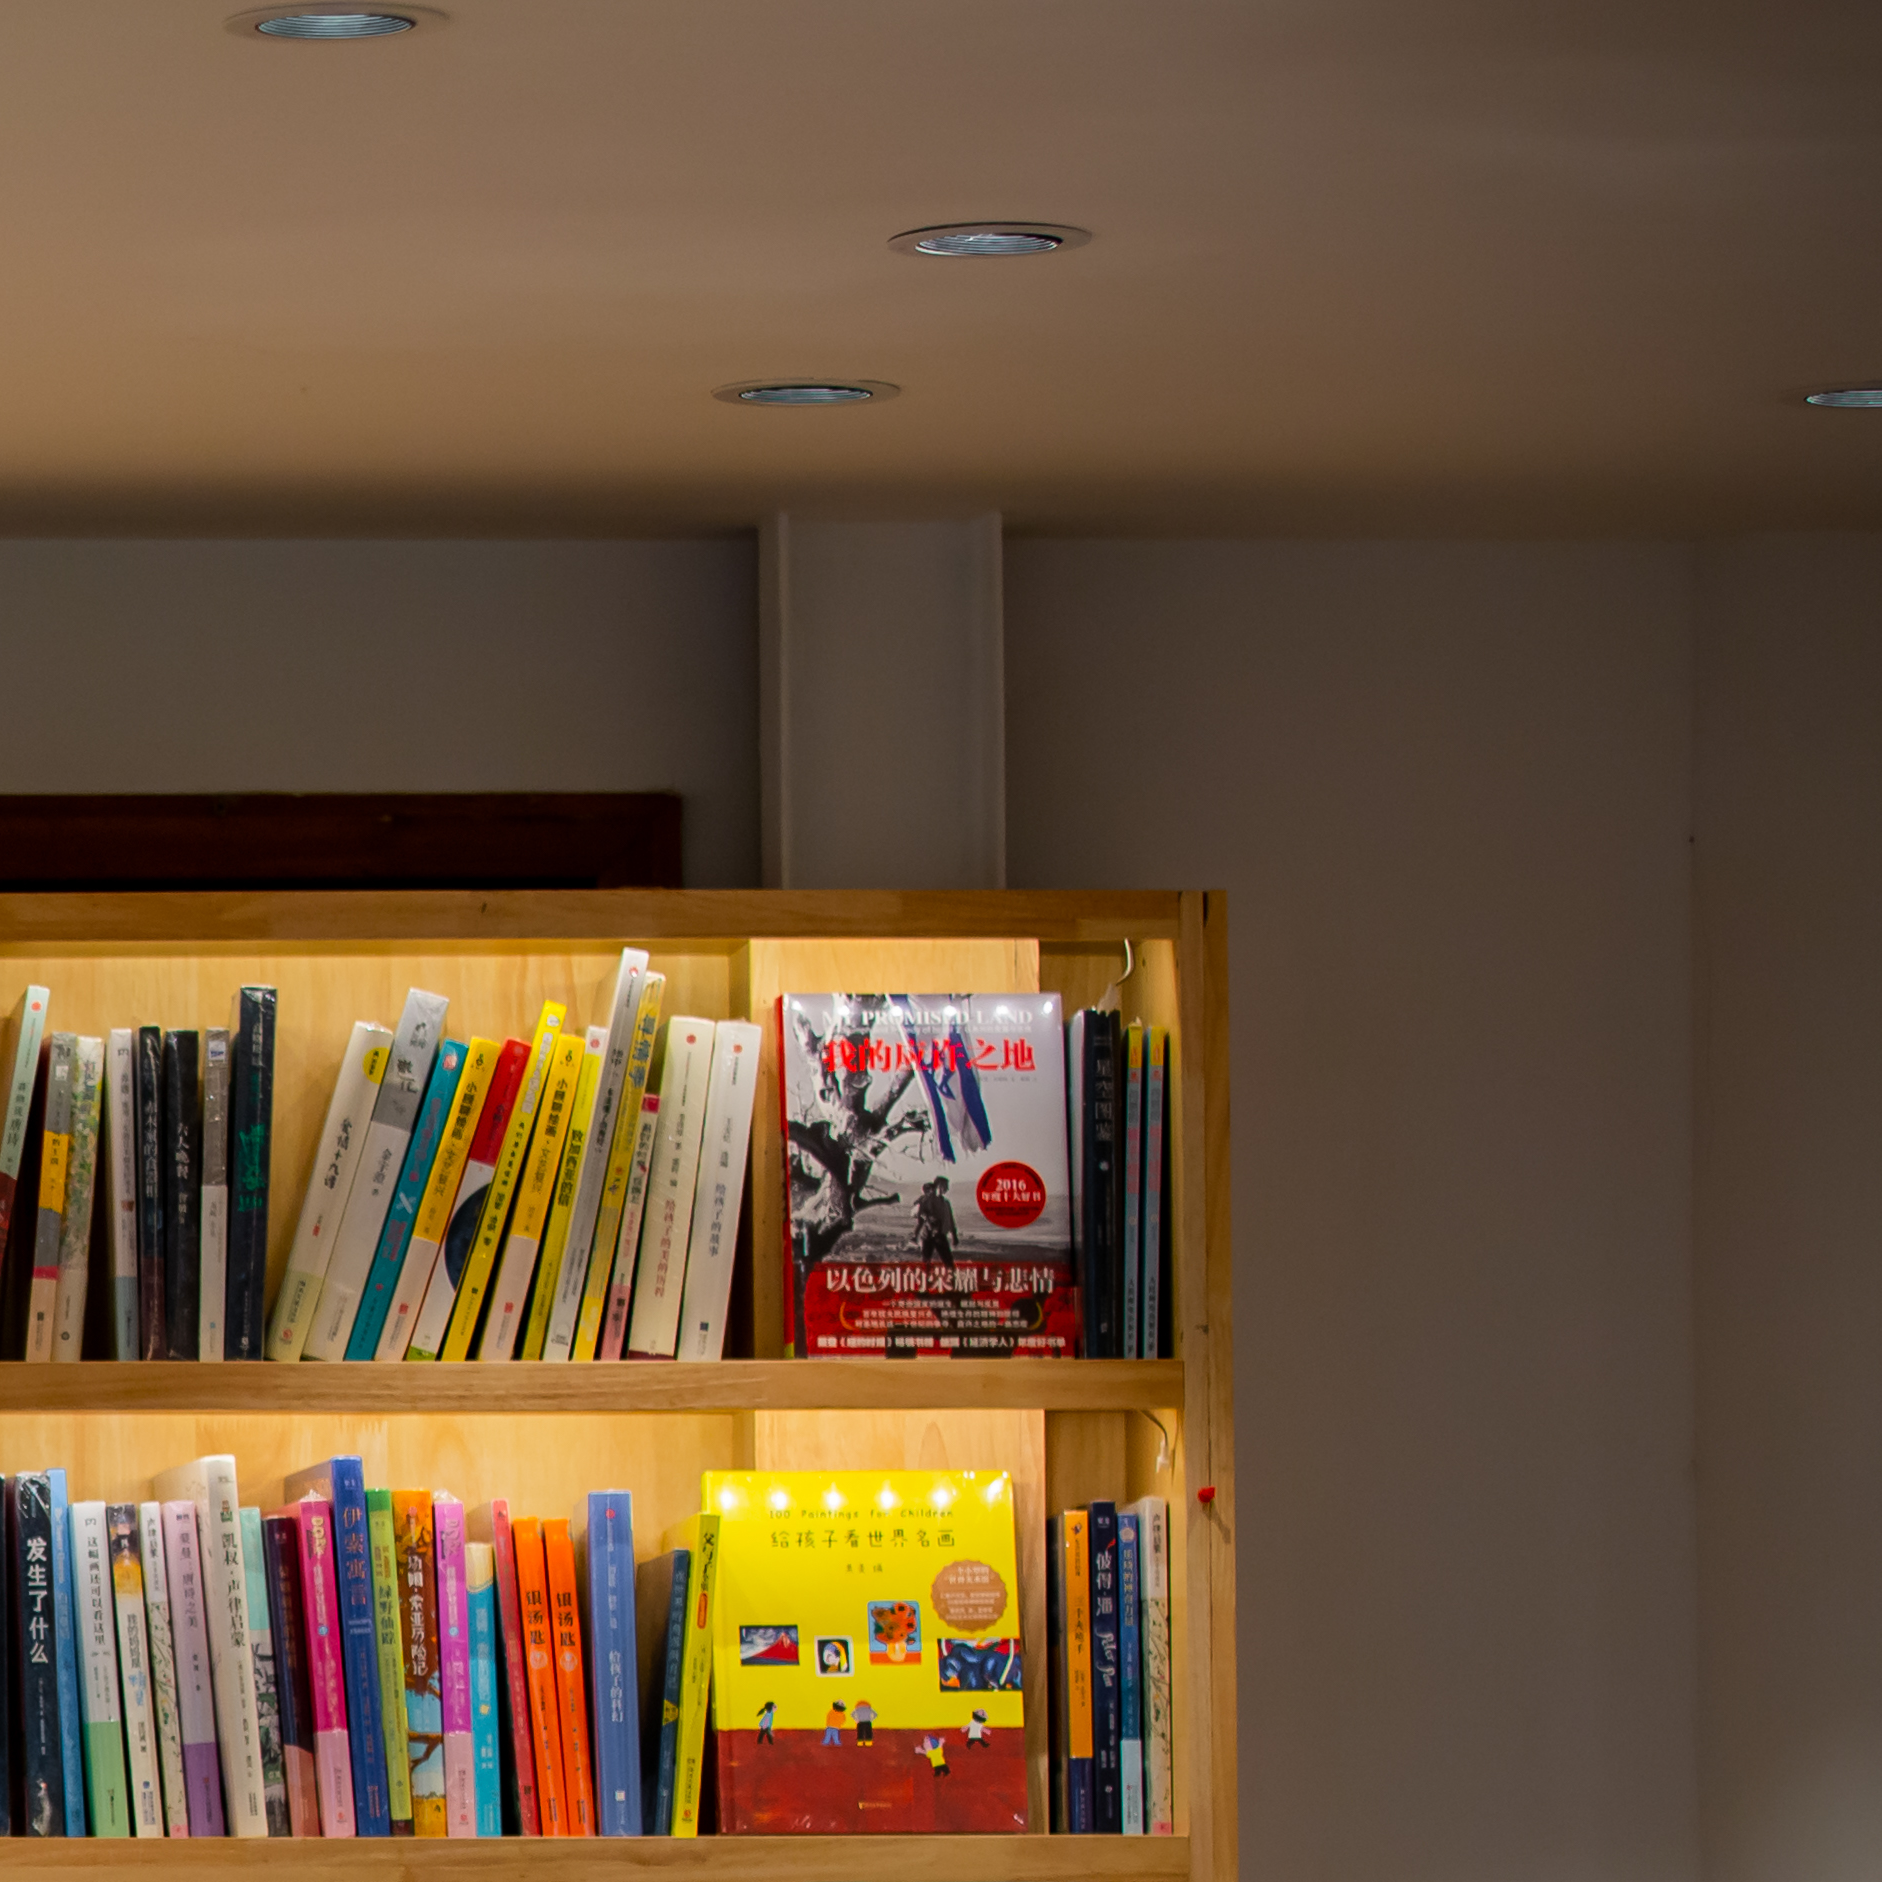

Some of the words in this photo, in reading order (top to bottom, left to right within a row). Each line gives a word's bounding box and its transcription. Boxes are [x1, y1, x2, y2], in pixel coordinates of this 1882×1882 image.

[976, 1009, 1034, 1025] LAND
[823, 1037, 1037, 1074] 我的应许之地
[995, 1178, 1028, 1193] 2016
[825, 1265, 1056, 1294] 以色列的荣耀与悲情
[769, 1510, 791, 1520] 100
[800, 1509, 860, 1522] Paintings
[899, 1509, 954, 1520] Children
[341, 1504, 368, 1607] 伊索寓言
[769, 1528, 957, 1550] 给孩子看世界名画
[26, 1535, 50, 1666] 发生了什么
[407, 1554, 429, 1677] 汤姆·索亚历险记
[525, 1589, 546, 1646] 银汤匙
[556, 1591, 576, 1648] 银汤匙
